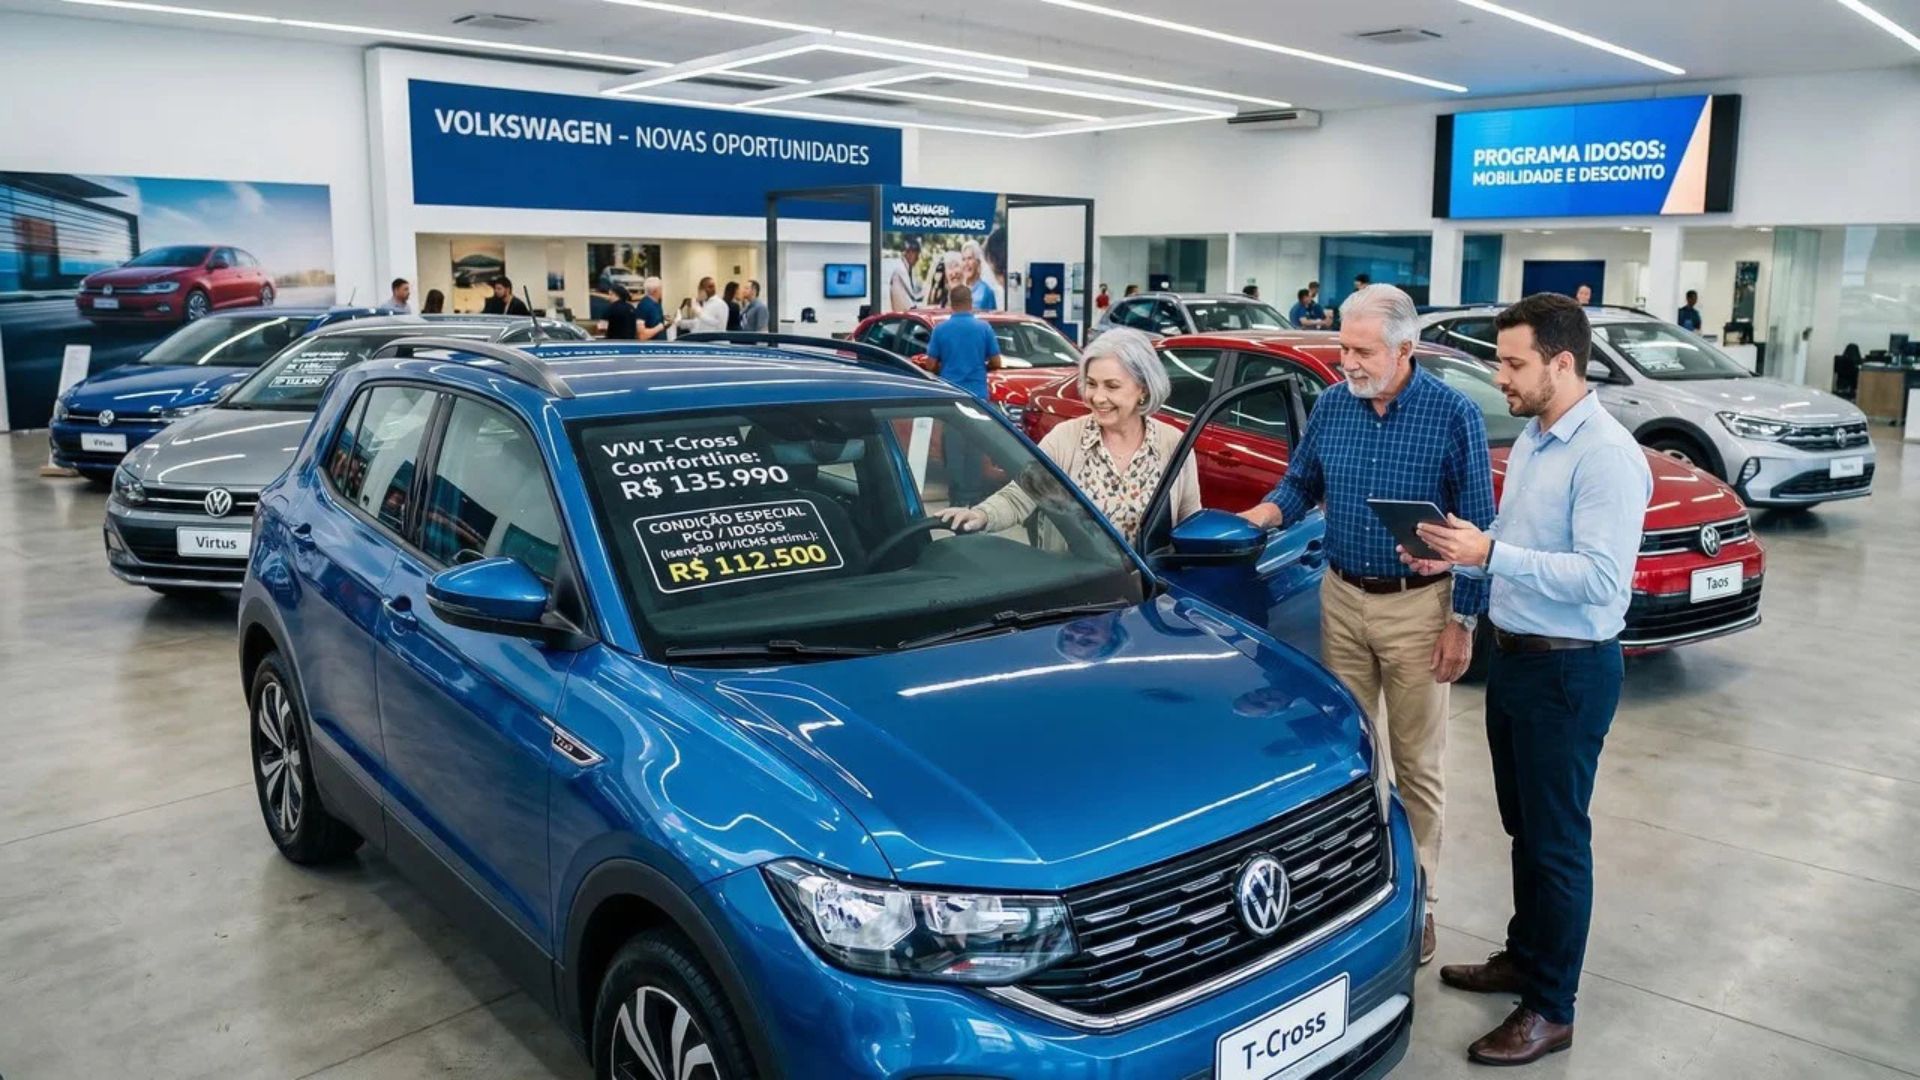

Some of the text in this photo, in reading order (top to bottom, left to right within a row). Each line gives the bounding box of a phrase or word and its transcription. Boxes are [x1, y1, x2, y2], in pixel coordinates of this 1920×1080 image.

[434, 109, 612, 146] VOLKSWAGEN
[636, 127, 706, 153] NOVAS
[712, 133, 870, 166] OPORTUNIDADES
[1473, 139, 1666, 168] PROGRAMA IDOSOS:
[1473, 164, 1666, 187] MOBILIDADE E DESCONTO
[892, 202, 949, 216] VOLKSWAGEN
[892, 215, 985, 230] NOVAS OPORTUNIDADES
[602, 435, 739, 457] VW T-Cross
[612, 451, 761, 477] Comfortline:
[620, 465, 789, 500] R$ 135.990
[649, 506, 807, 534] CONDIÇÃO ESPECIAL
[682, 530, 714, 543] PCD
[729, 521, 786, 537] IDOSOS
[196, 536, 237, 549] Virtus
[669, 545, 827, 582] R$ 112.500
[1706, 577, 1729, 590] Taos
[1242, 1012, 1326, 1069] T-Cross
